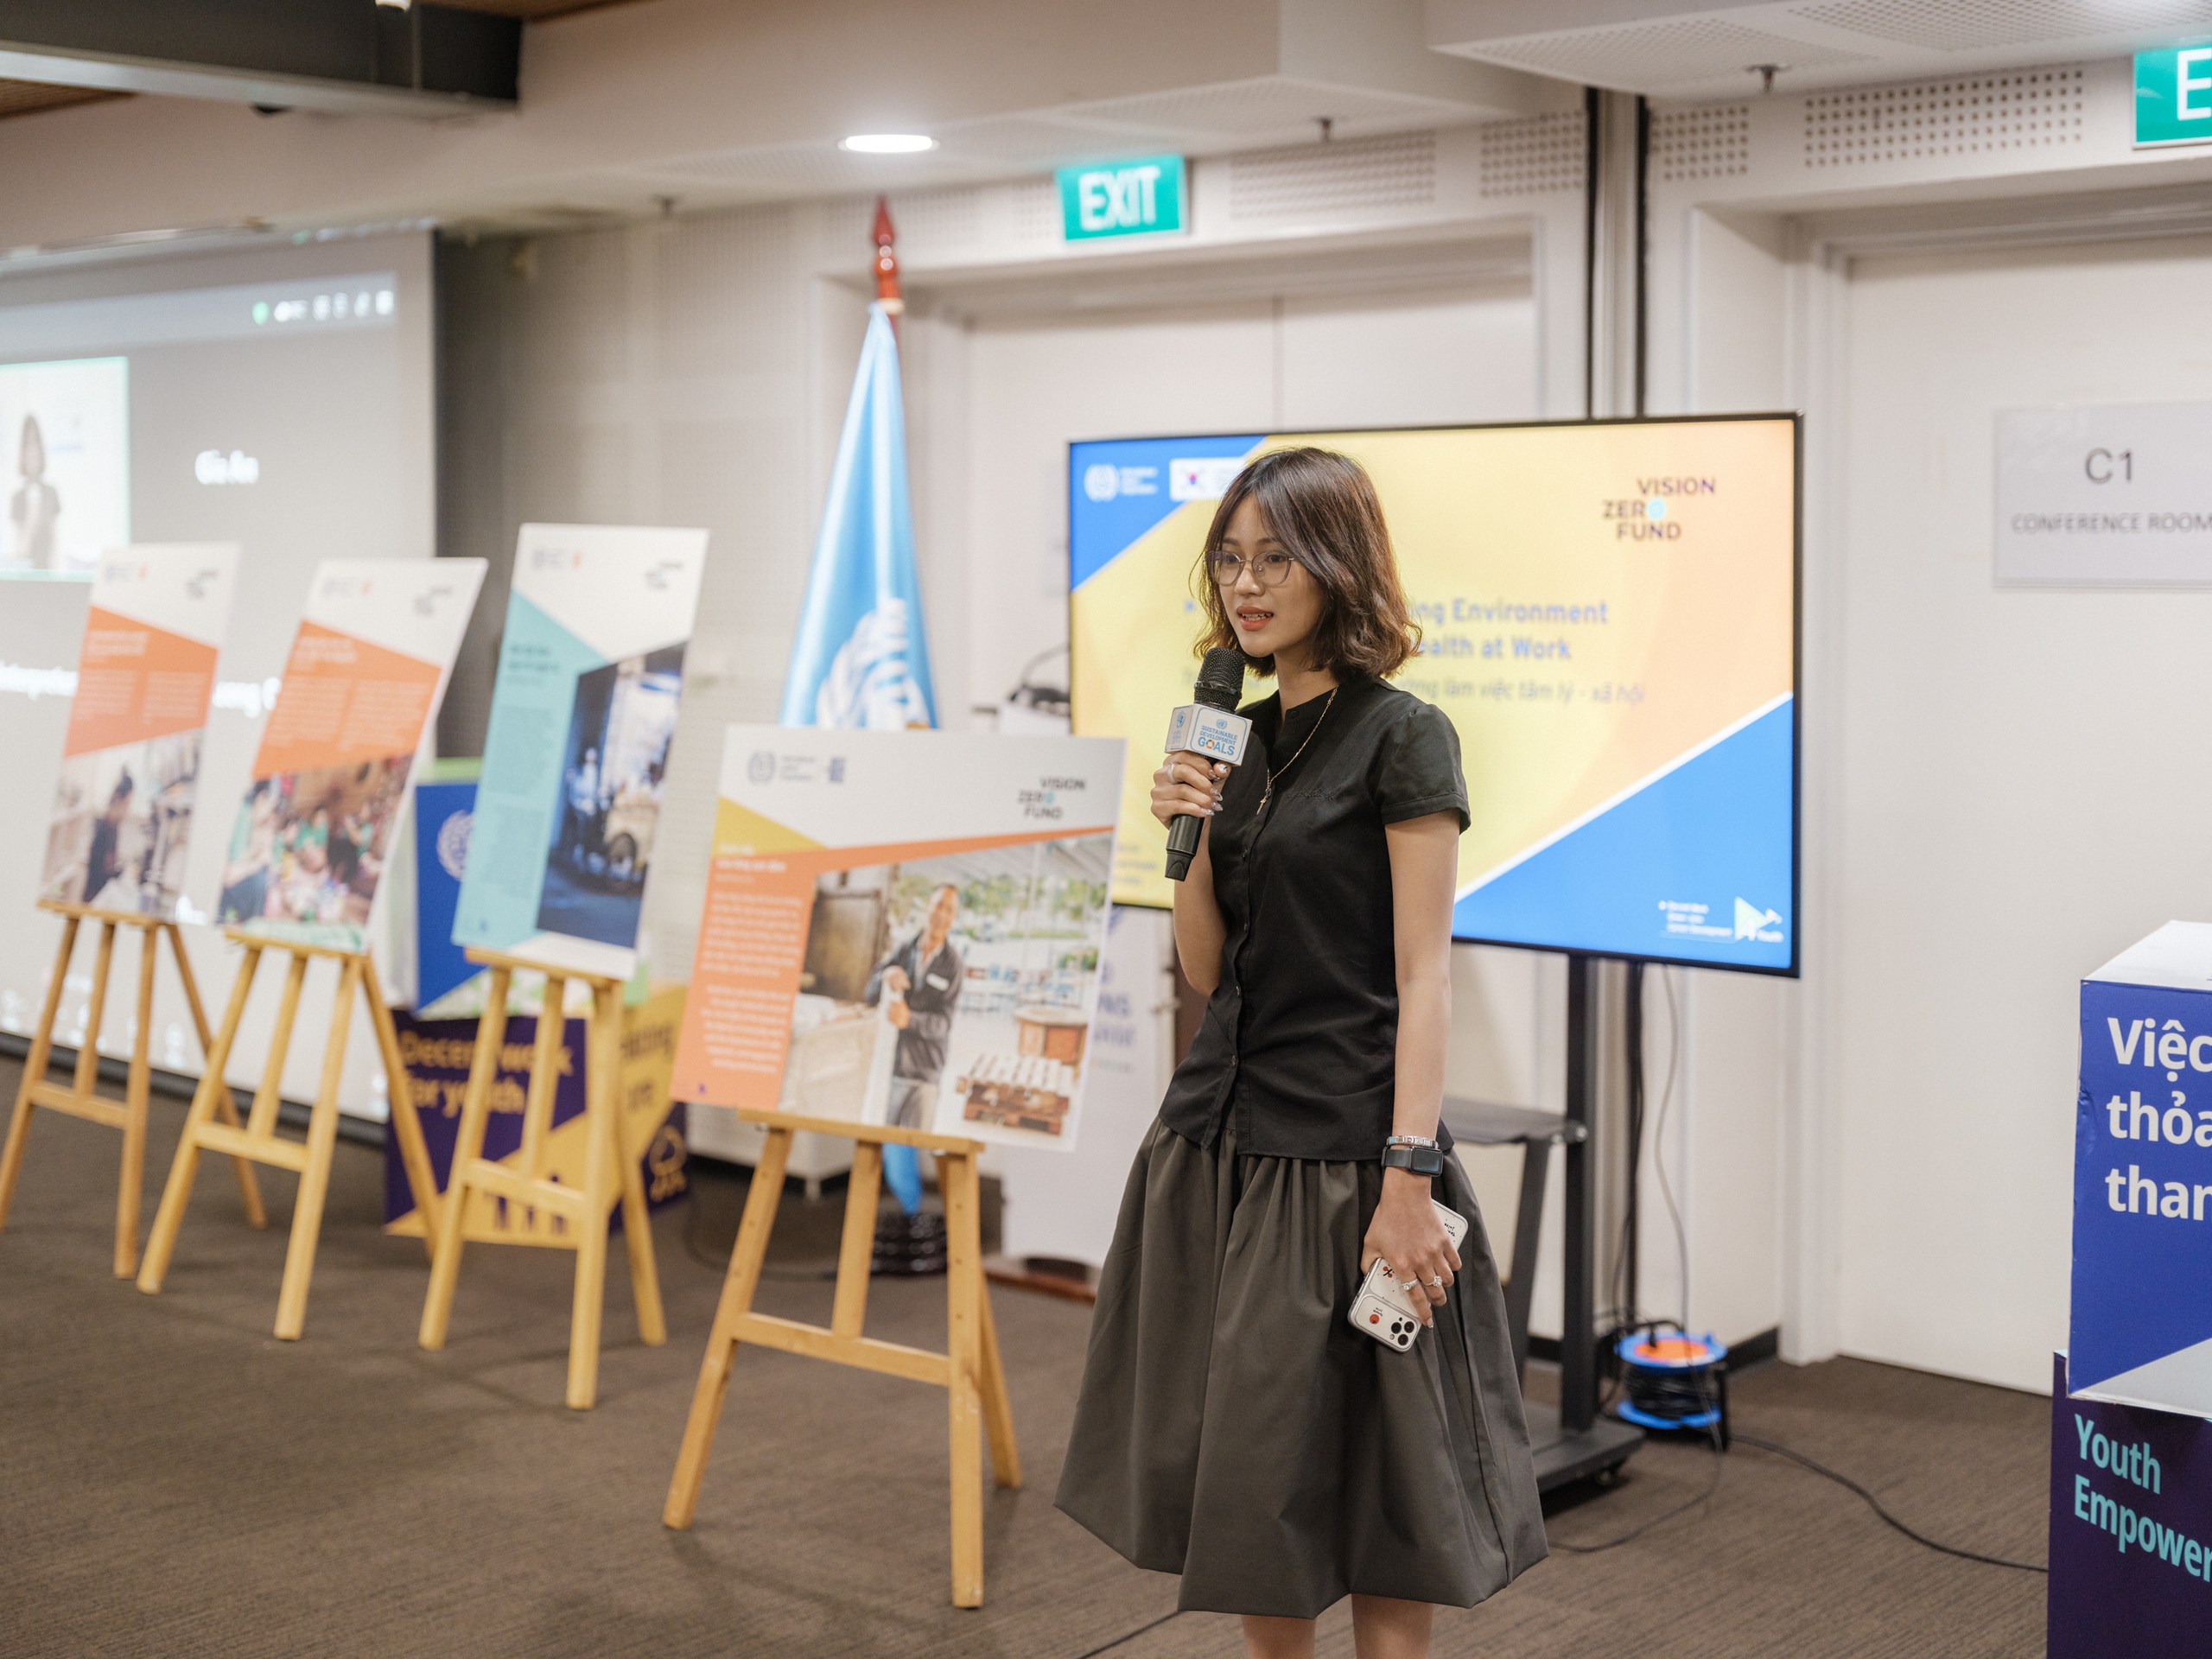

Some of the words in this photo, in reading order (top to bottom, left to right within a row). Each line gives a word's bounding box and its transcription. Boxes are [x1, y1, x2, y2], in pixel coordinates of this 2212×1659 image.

[1077, 165, 1161, 232] EXIT
[2085, 447, 2132, 484] C1
[1637, 476, 1716, 497] VISION
[1616, 521, 1681, 542] FUND
[2011, 512, 2143, 535] CONFERENCE
[1452, 596, 1608, 624] Environment
[1481, 639, 1503, 658] at
[1512, 636, 1571, 659] Work
[1199, 730, 1236, 746] DEVELOPMENT
[1201, 725, 1238, 741] SUSTAINABLE
[1198, 736, 1236, 756] GOALS
[2107, 1017, 2212, 1082] Việc
[2075, 1414, 2160, 1495] Youth
